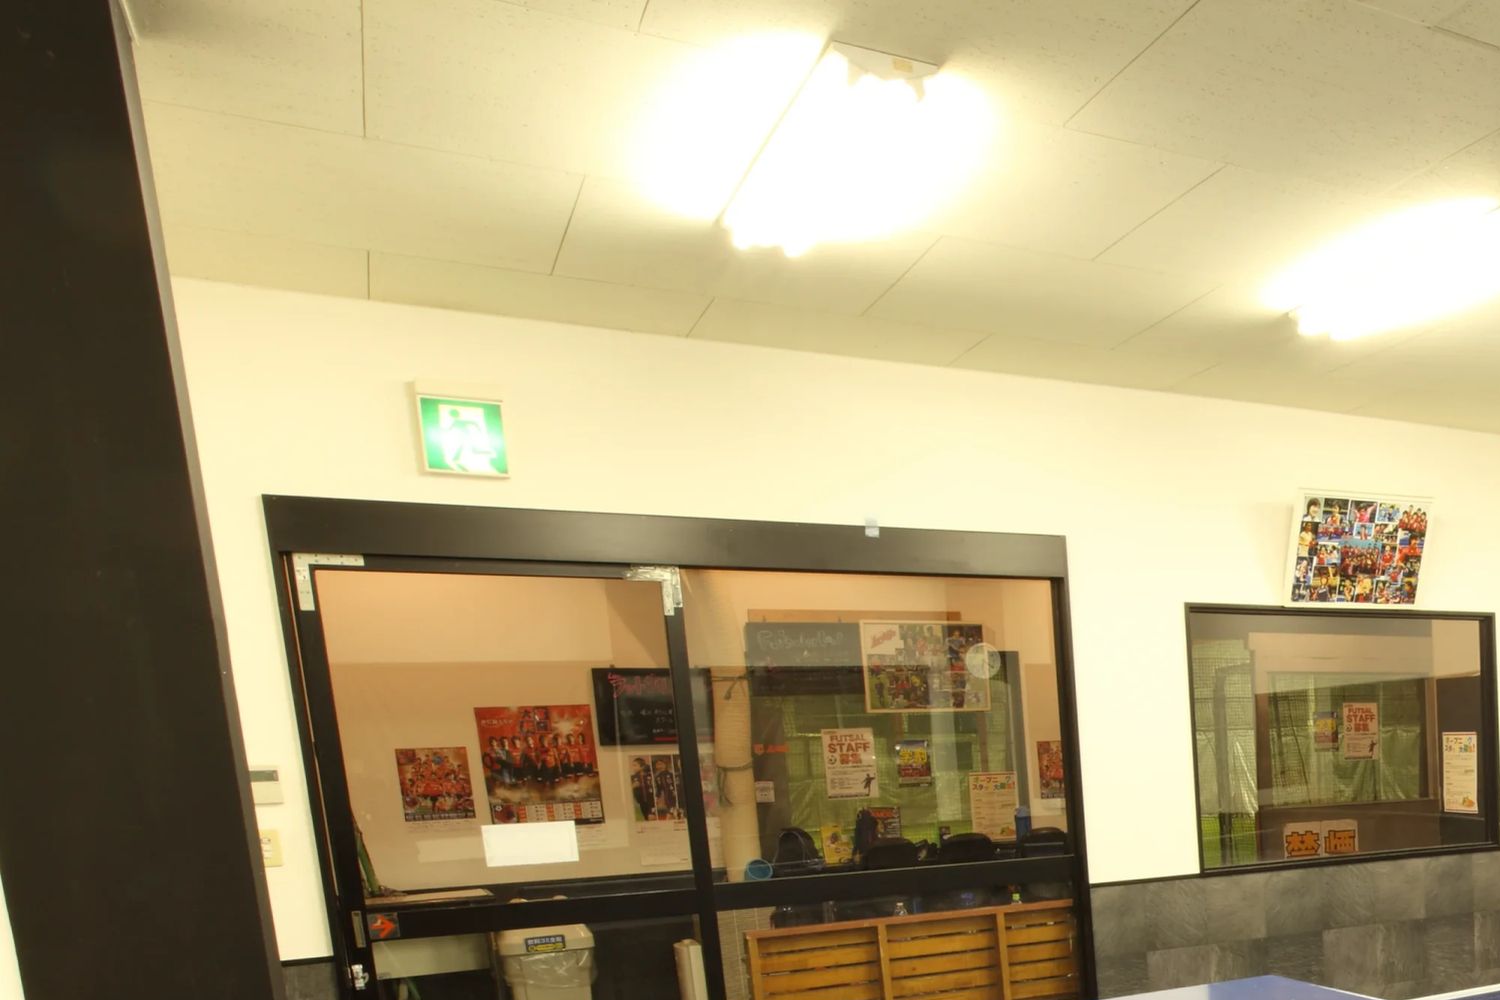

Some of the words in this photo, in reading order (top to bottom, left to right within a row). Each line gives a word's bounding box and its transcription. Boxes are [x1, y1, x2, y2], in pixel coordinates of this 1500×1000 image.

[1346, 714, 1376, 723] STAFF
[830, 734, 865, 743] FUTSAL
[828, 742, 870, 753] STAFF
